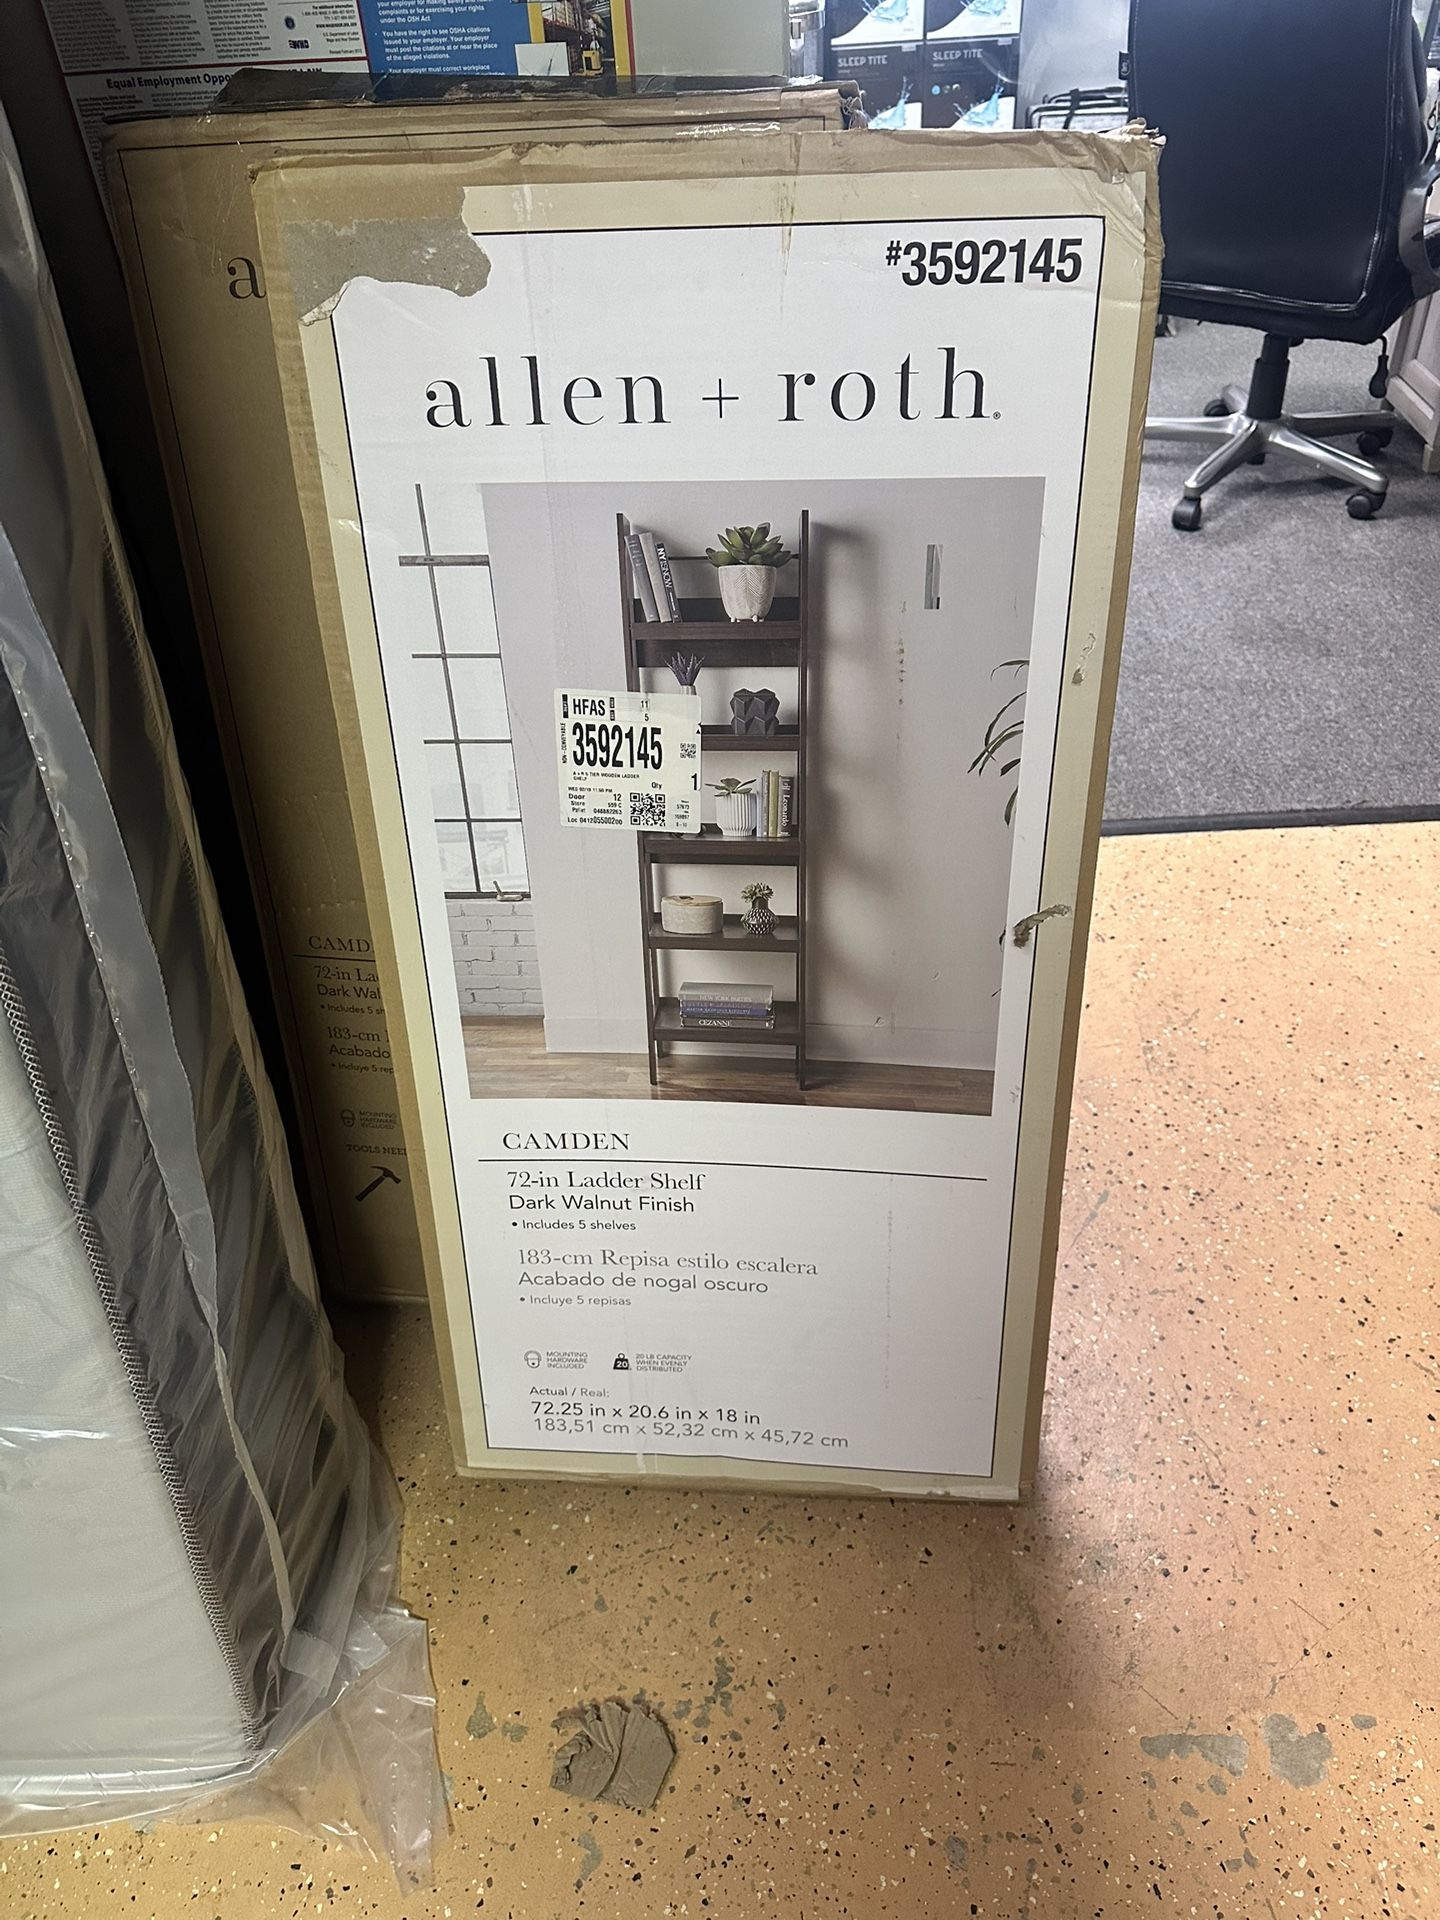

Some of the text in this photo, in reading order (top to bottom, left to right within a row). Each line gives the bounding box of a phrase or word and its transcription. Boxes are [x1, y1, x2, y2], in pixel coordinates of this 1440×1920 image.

[418, 29, 431, 37] right
[838, 55, 889, 67] SLEEP TITE
[933, 49, 984, 61] SLEEP TITE
[107, 72, 233, 90] Equal Employment Oppo
[886, 237, 1083, 286] #3592145
[424, 355, 672, 429] allen
[702, 378, 739, 418] +
[572, 698, 606, 716] HFAS
[640, 699, 649, 709] 11
[644, 713, 650, 722] 5
[572, 721, 663, 770] 3592145
[651, 781, 663, 790] Qty
[691, 773, 698, 791] 1
[613, 793, 622, 802] 12
[308, 935, 373, 952] CAMD
[313, 965, 351, 981] 72-in
[316, 983, 351, 998] Dark
[327, 1003, 365, 1014] Includes
[367, 1006, 374, 1014] 5
[327, 1025, 381, 1042] 183-cm
[328, 1044, 391, 1059] Acabado
[337, 1063, 369, 1073] Incluye
[371, 1064, 378, 1072] 5
[502, 1131, 632, 1151] CAMDEN
[346, 1144, 380, 1153] TOOLS
[507, 1170, 707, 1191] 72-in Ladder Shelf
[509, 1193, 696, 1213] Dark Walnut Finish
[522, 1218, 637, 1231] Includes 5 shelves
[519, 1247, 818, 1276] 183-cm Repisa estilo escalera
[518, 1270, 769, 1295] Acabado de nogal oscuro
[529, 1294, 632, 1308] Incluye 5 repisas
[546, 1350, 588, 1358] MOUNTING
[547, 1356, 588, 1364] HARDWARE
[547, 1362, 585, 1370] INCLUDED
[616, 1360, 629, 1369] 20
[636, 1358, 688, 1367] WHEN EVENLY
[636, 1365, 684, 1373] DISTRIBUTED
[529, 1385, 568, 1397] Actual
[580, 1387, 610, 1399] Real:
[530, 1400, 761, 1425] 72.25 in x 20.6 in x 18 in
[533, 1417, 850, 1450] 183,51 cm x 52,32 cm x 45,72 cm
